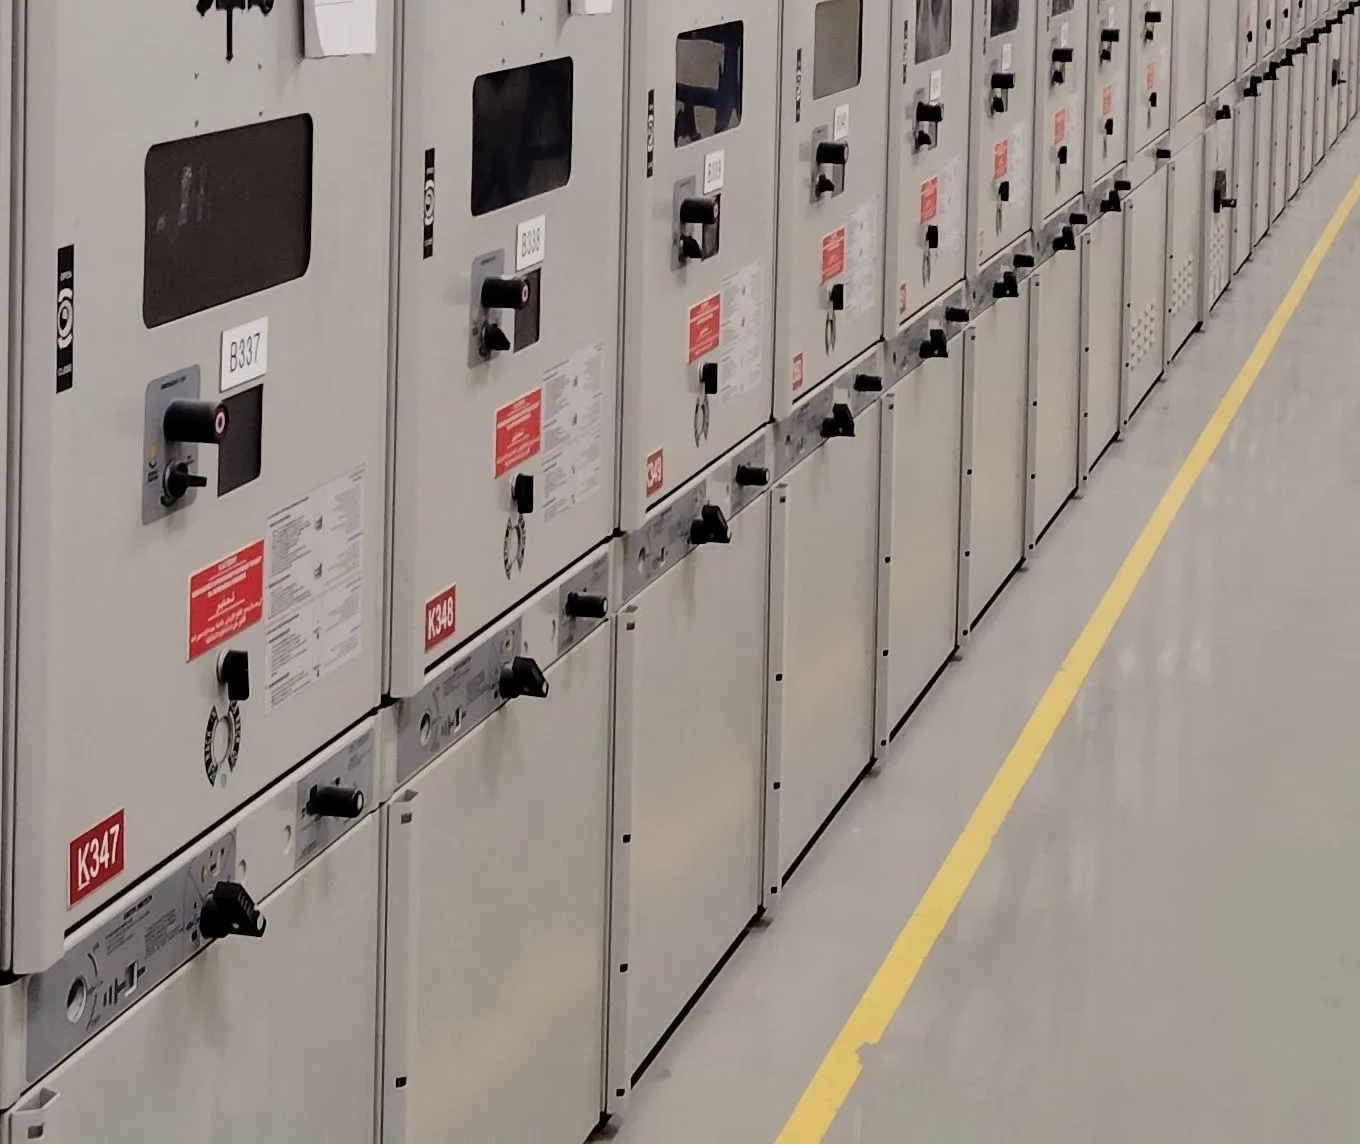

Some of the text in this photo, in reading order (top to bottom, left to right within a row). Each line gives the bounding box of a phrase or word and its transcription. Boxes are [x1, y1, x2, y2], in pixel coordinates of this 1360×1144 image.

[229, 332, 261, 373] B337
[427, 596, 454, 641] K348
[77, 823, 120, 892] K347
